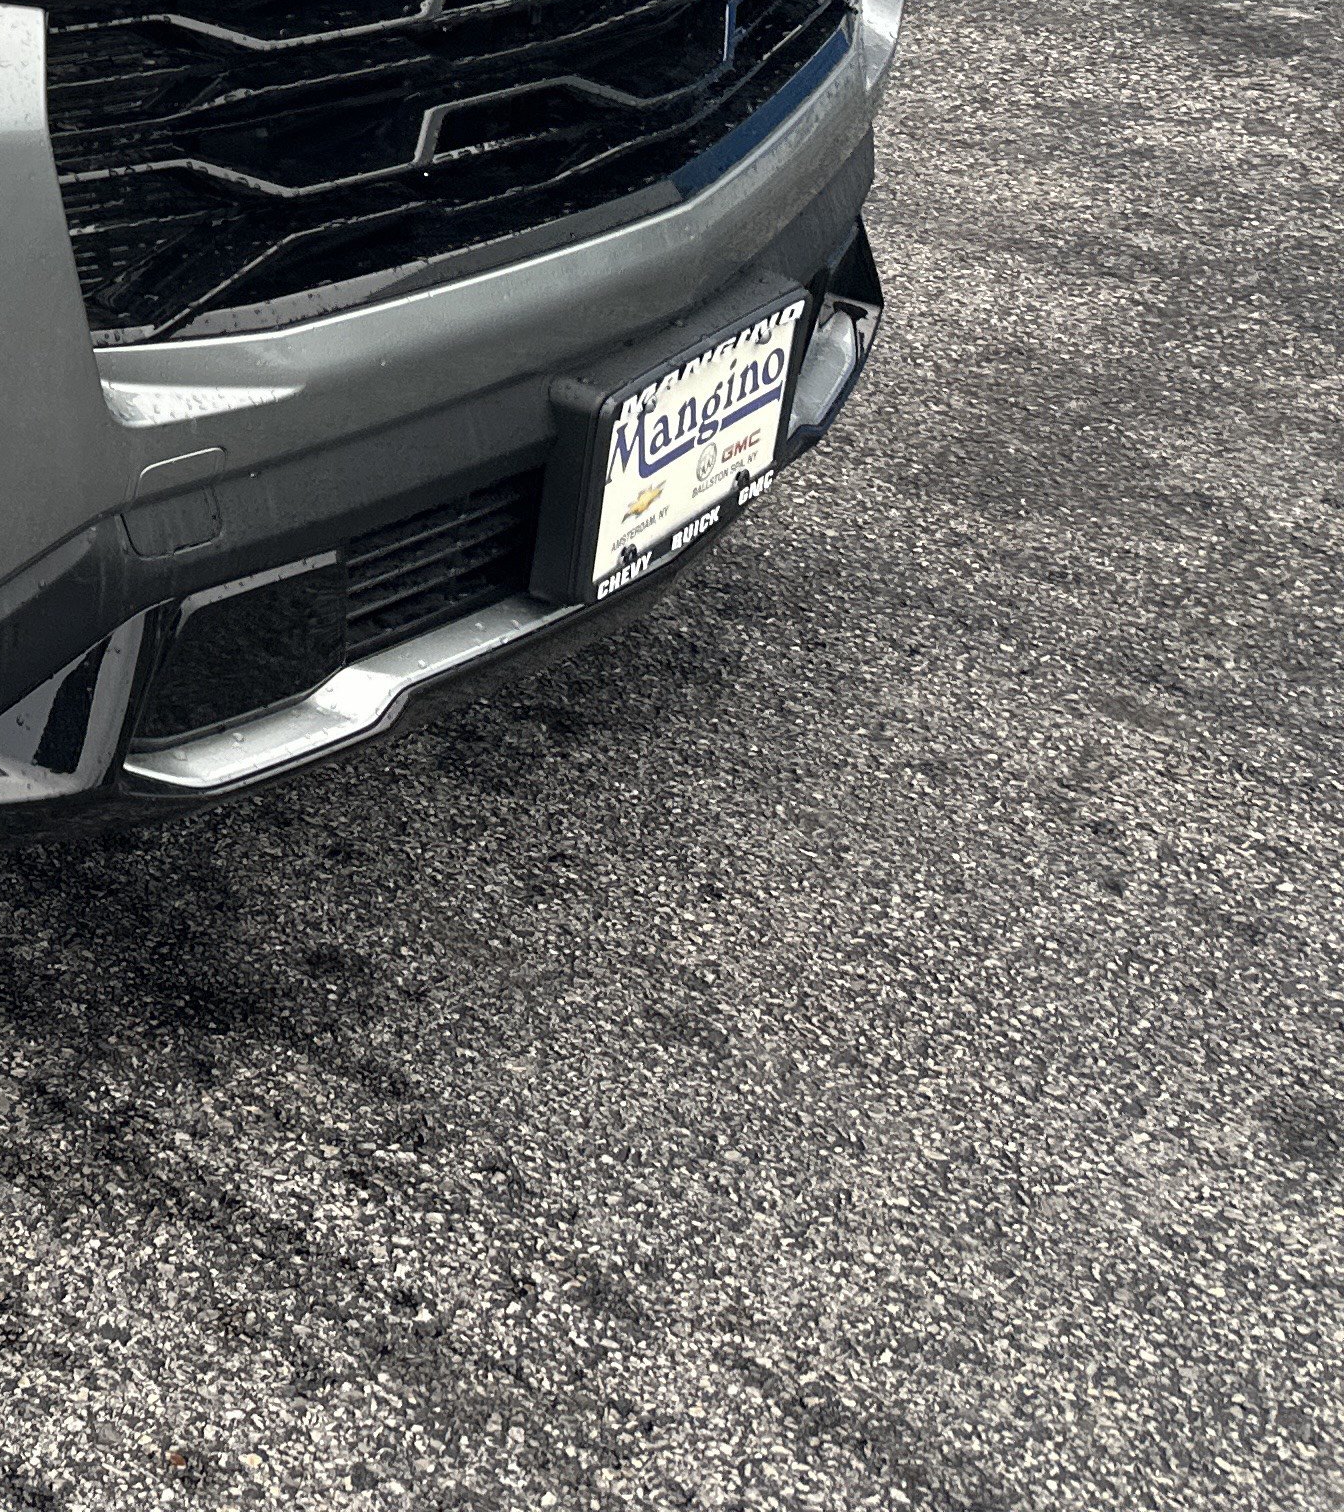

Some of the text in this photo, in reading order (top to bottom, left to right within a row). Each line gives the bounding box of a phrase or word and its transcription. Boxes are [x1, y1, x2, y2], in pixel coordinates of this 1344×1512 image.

[605, 347, 785, 484] Mangino
[721, 428, 762, 464] GMC
[597, 469, 775, 600] CHEVY BUICK GMC
